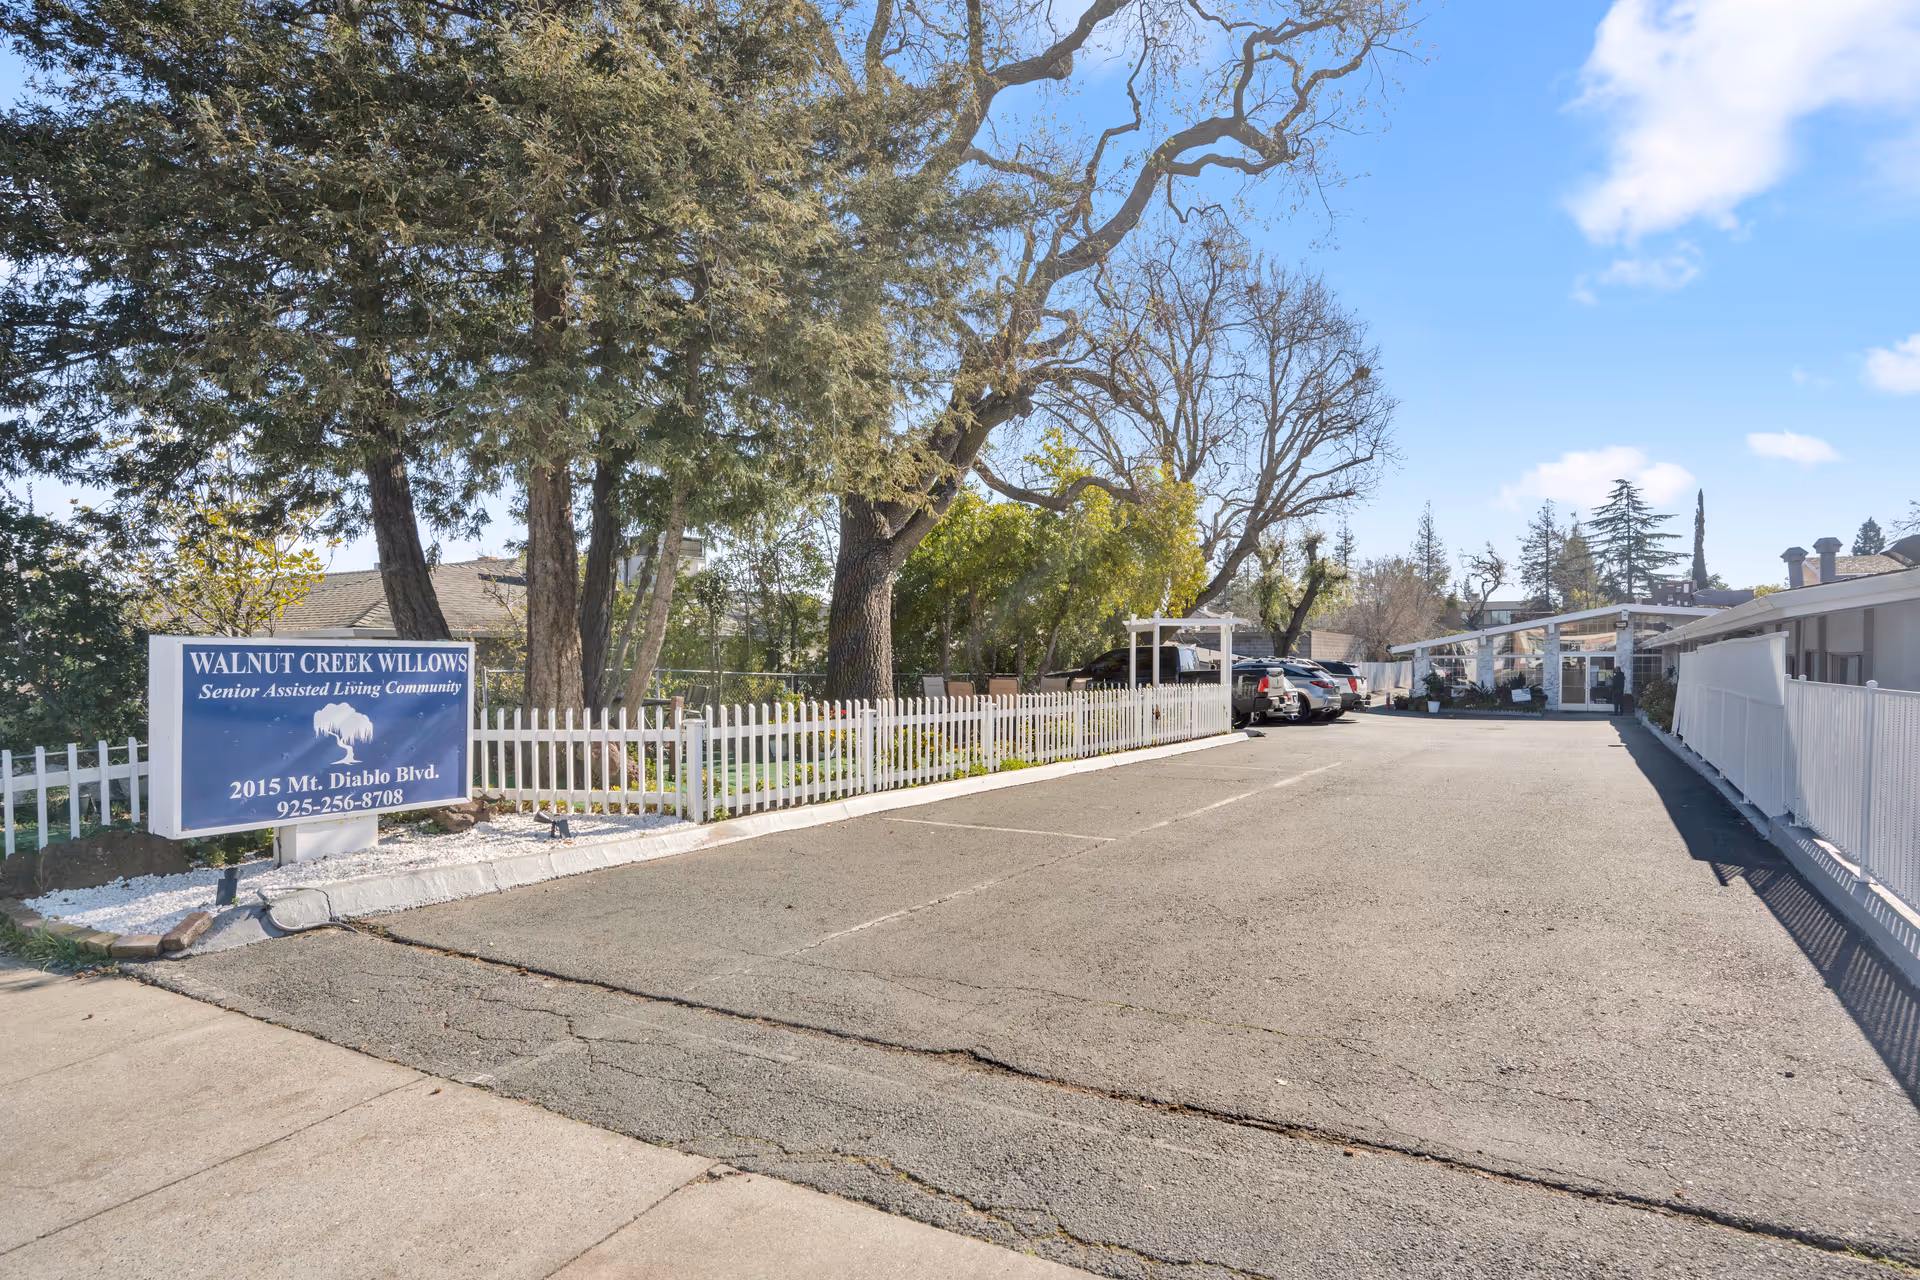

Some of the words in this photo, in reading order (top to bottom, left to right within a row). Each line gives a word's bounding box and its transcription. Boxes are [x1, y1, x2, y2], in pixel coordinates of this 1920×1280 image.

[189, 652, 295, 675] WALNUT
[300, 652, 374, 674] CREEK
[377, 653, 468, 673] WILLOWS
[198, 683, 260, 699] Senior
[262, 682, 330, 698] Assisted
[332, 681, 381, 698] Living
[385, 680, 462, 695] Community
[229, 777, 281, 799] 2015
[286, 775, 323, 794] Mt.
[329, 769, 391, 790] Diablo
[396, 764, 440, 783] Blvd.
[276, 789, 404, 819] 925-256-8708
